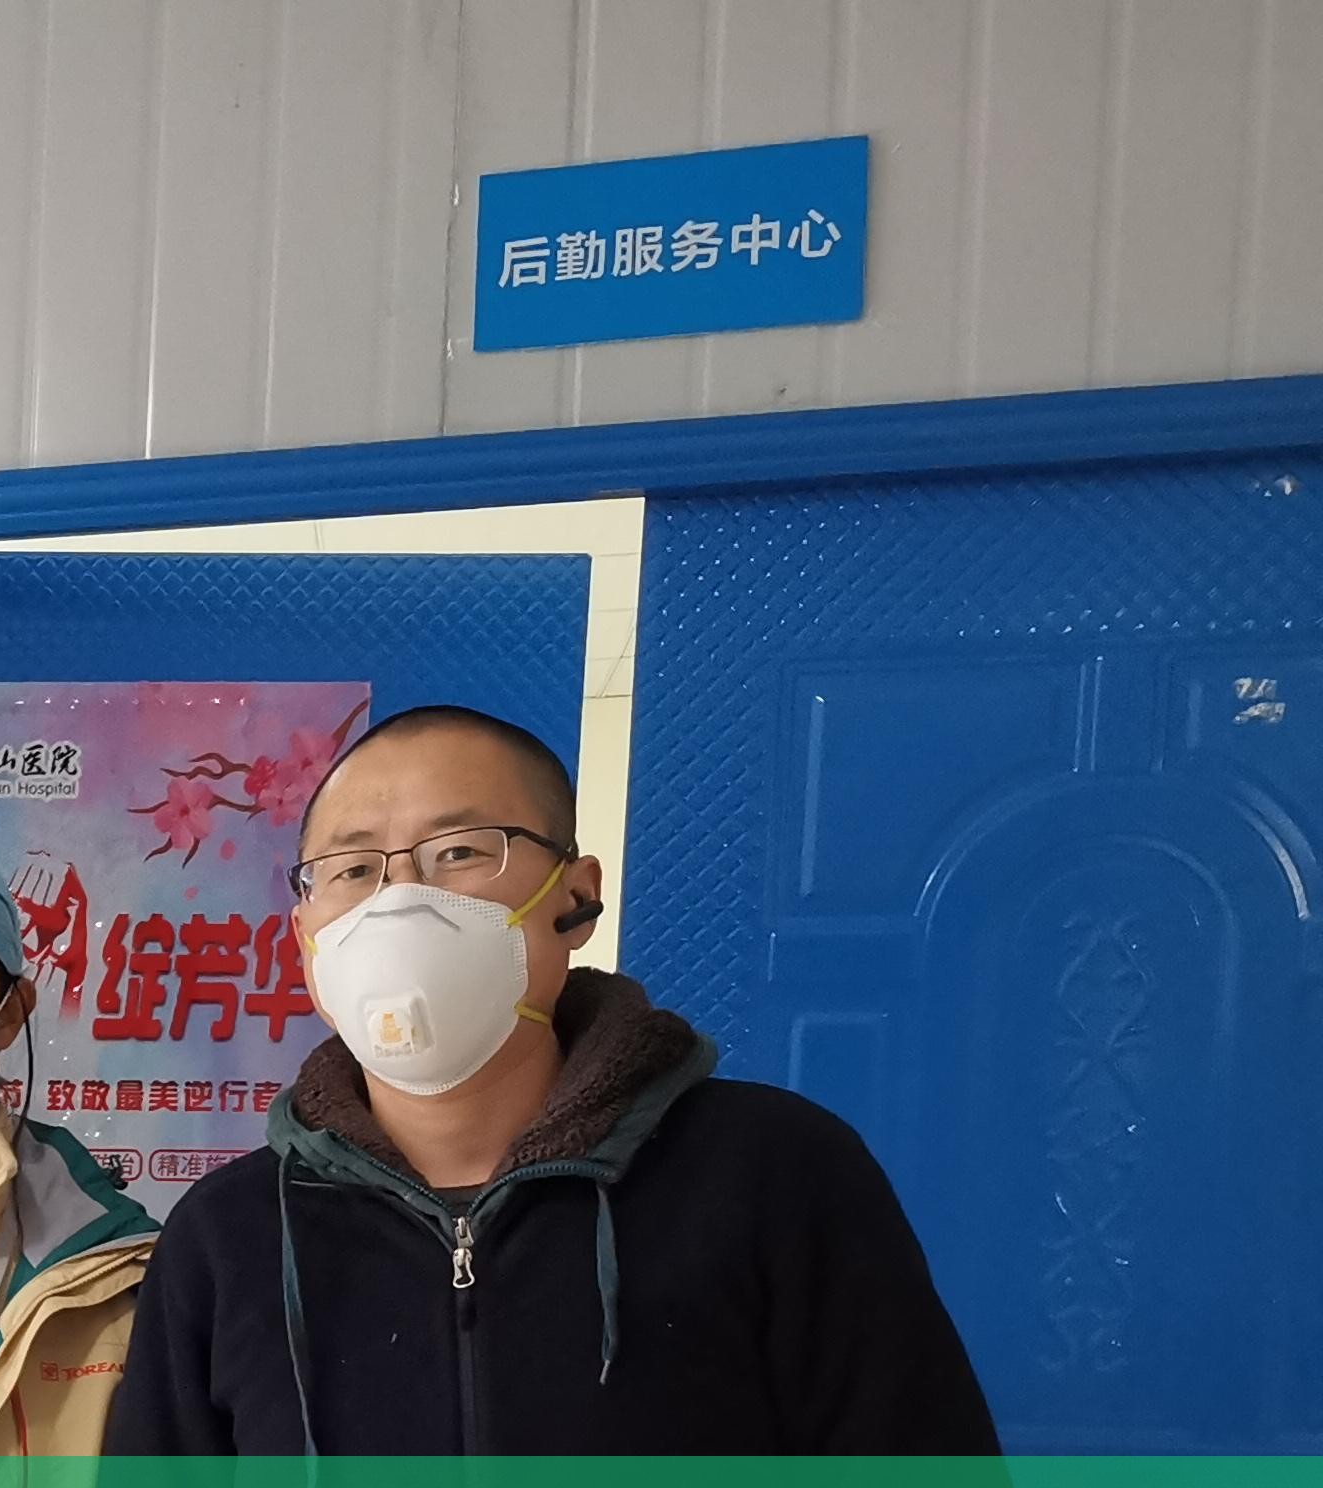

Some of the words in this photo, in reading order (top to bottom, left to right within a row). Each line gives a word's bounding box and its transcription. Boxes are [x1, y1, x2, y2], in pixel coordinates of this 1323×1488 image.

[498, 208, 842, 288] 后勤服务中心
[17, 780, 77, 797] Hospital
[46, 1079, 283, 1113] 致敬最美逆行者
